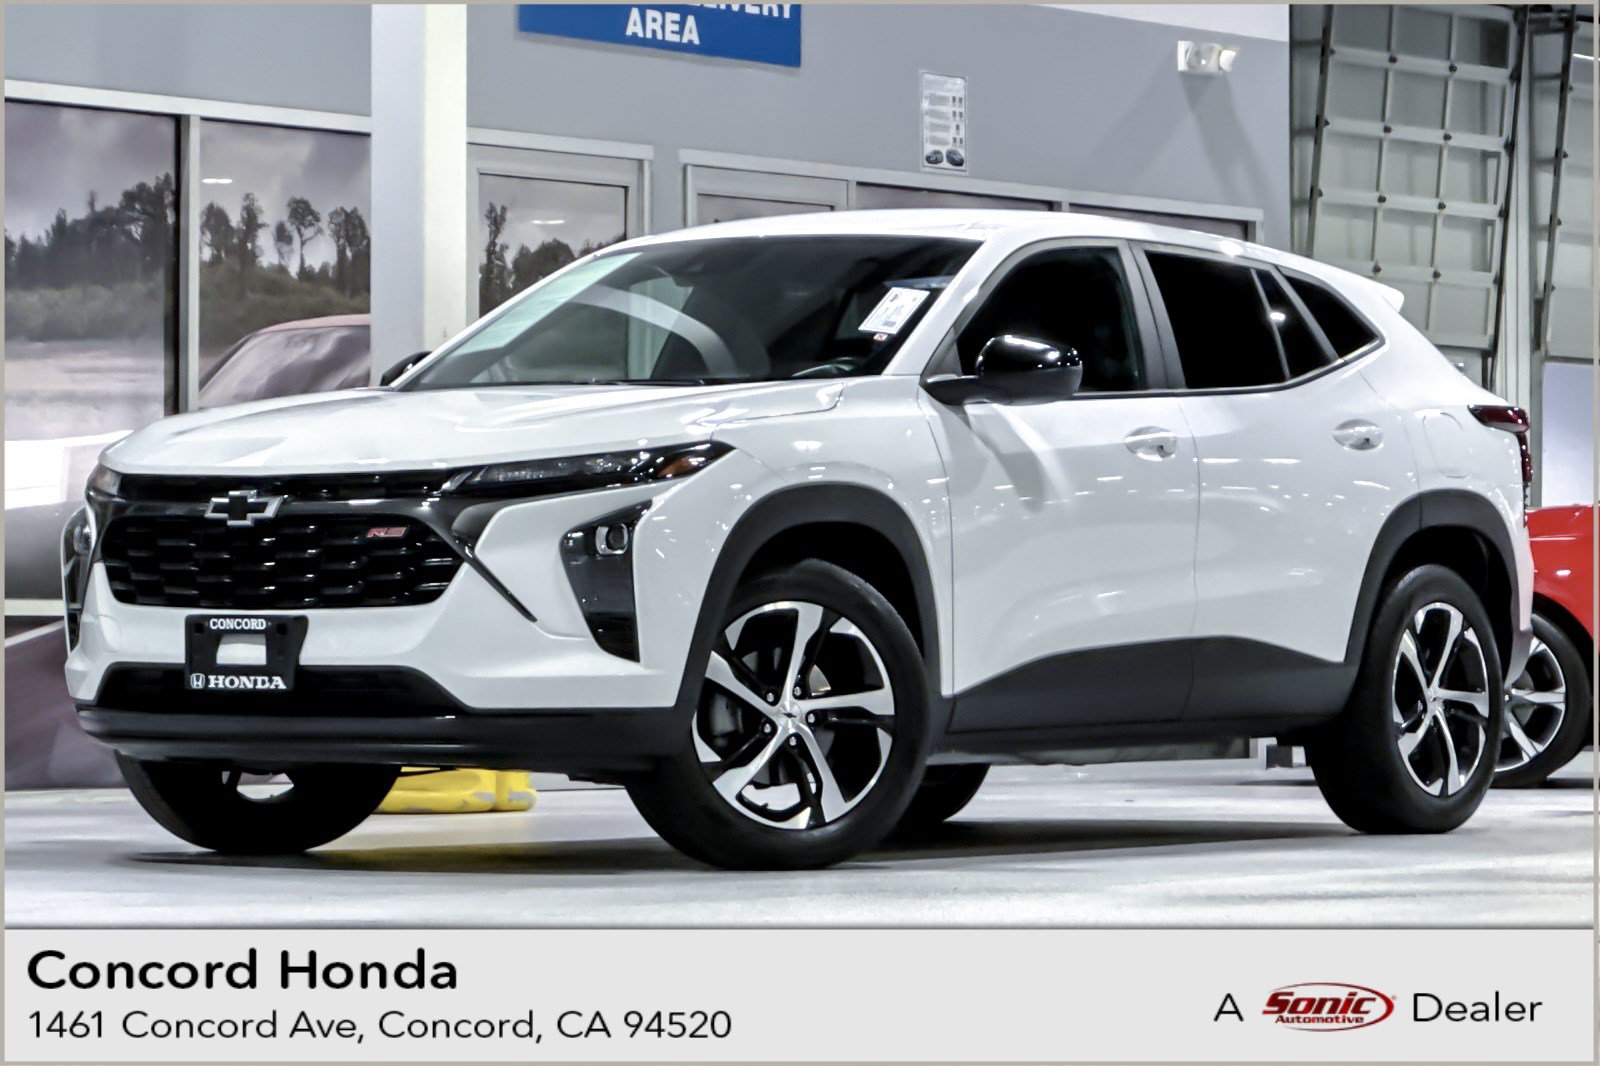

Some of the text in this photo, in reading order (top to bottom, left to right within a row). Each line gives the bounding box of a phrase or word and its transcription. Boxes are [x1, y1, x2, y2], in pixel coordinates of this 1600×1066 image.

[625, 7, 700, 45] AREA
[209, 618, 267, 630] CONCORD
[208, 674, 287, 689] HONDA
